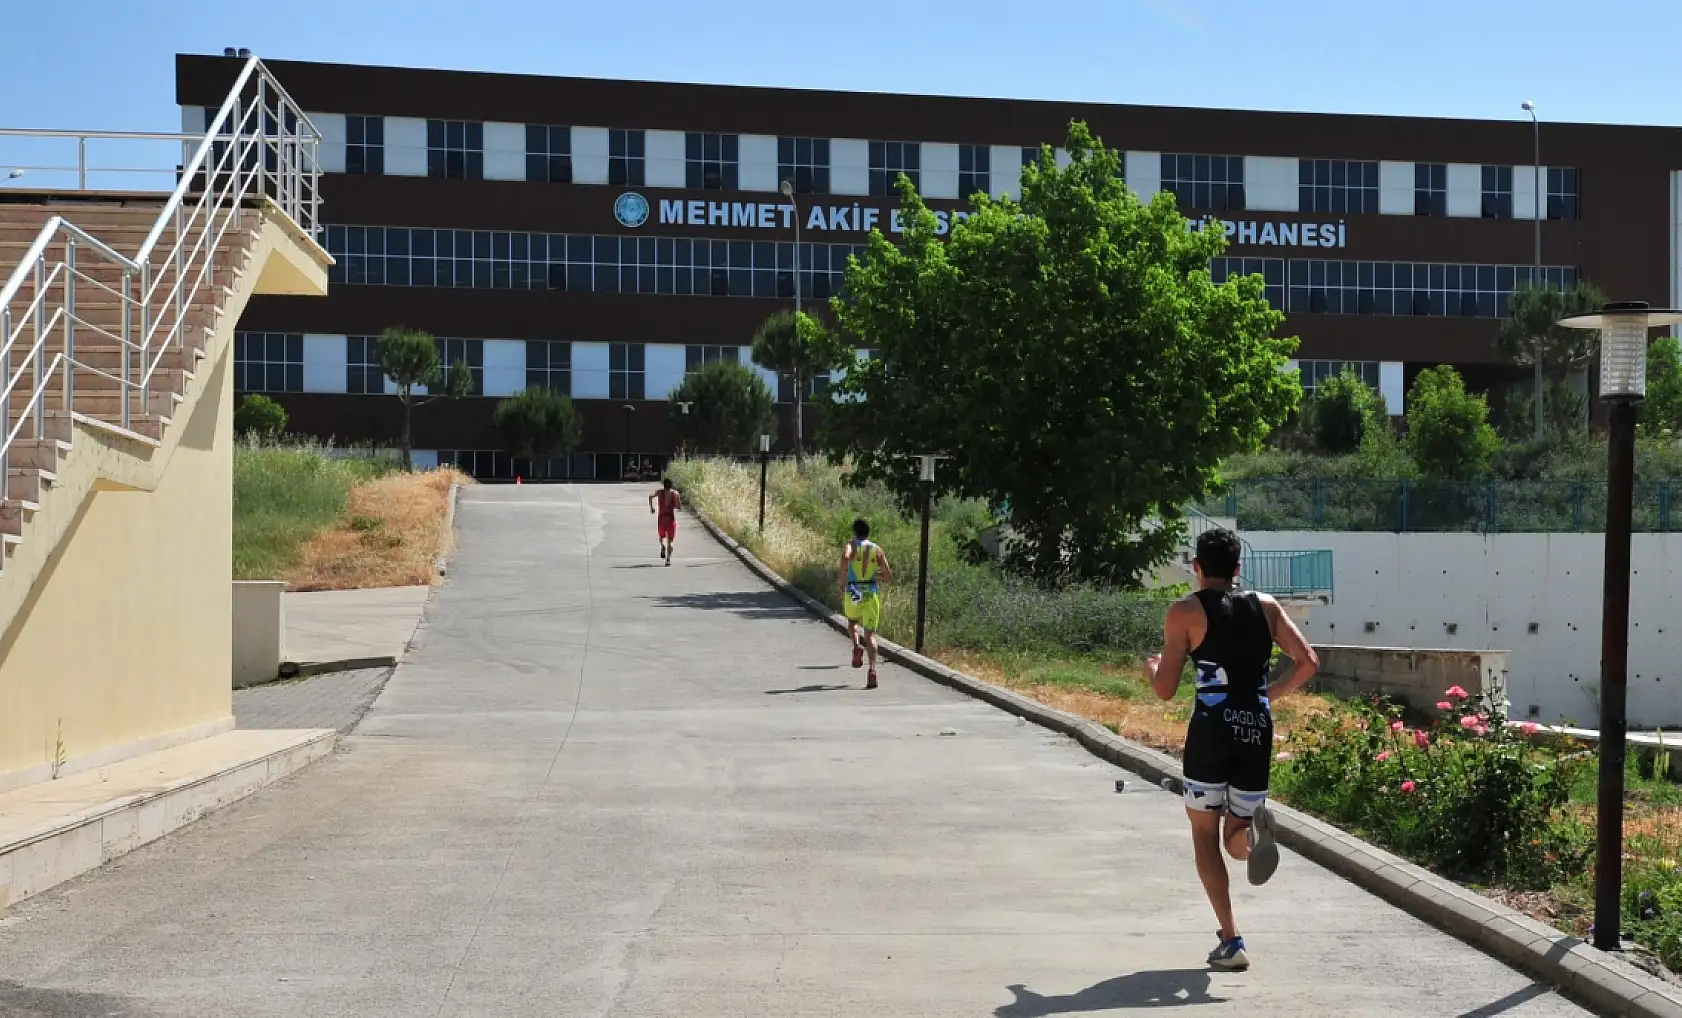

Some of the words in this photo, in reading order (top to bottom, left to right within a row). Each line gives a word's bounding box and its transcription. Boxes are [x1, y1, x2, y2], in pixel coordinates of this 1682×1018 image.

[659, 199, 795, 228] MEHMET
[806, 202, 880, 231] AKİF
[1231, 725, 1262, 746] TUR
